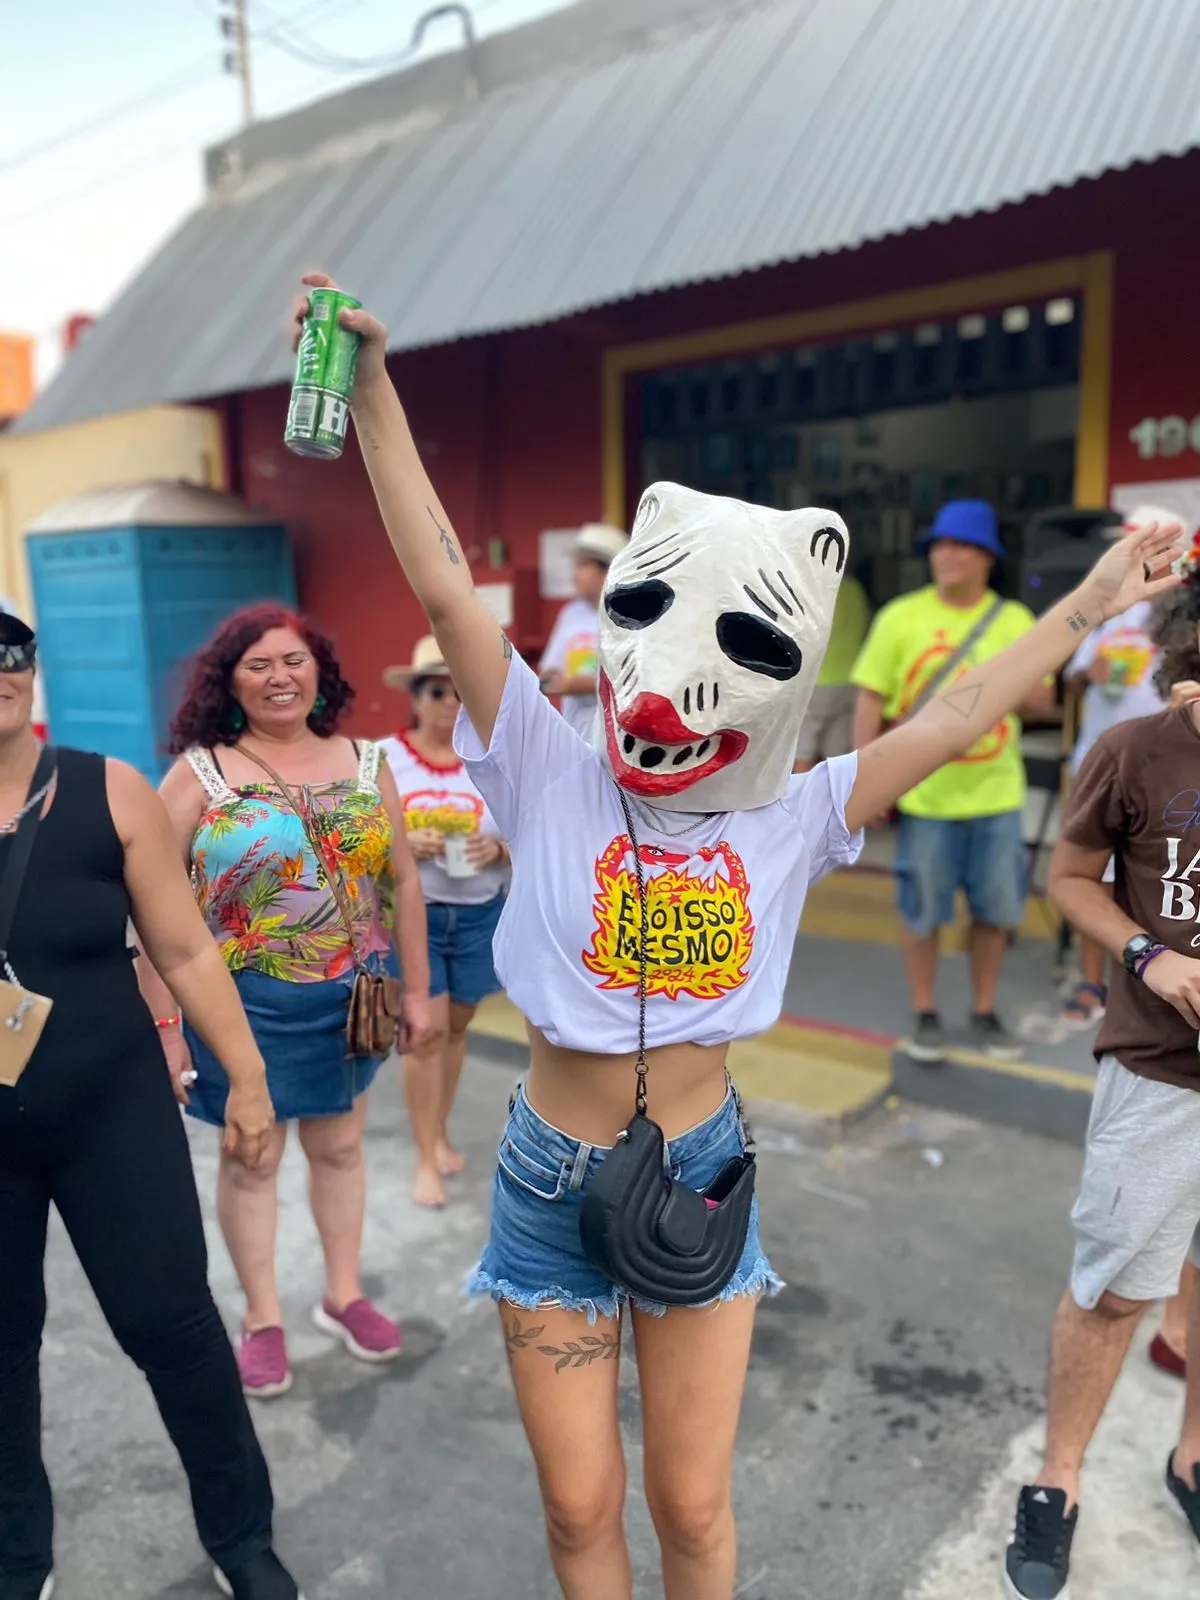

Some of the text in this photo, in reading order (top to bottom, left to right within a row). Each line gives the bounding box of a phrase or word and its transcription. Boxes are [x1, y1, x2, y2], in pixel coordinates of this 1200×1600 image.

[674, 898, 736, 931] ISSO
[1160, 879, 1200, 924] B
[614, 923, 733, 965] MESMO
[649, 968, 696, 983] 2024
